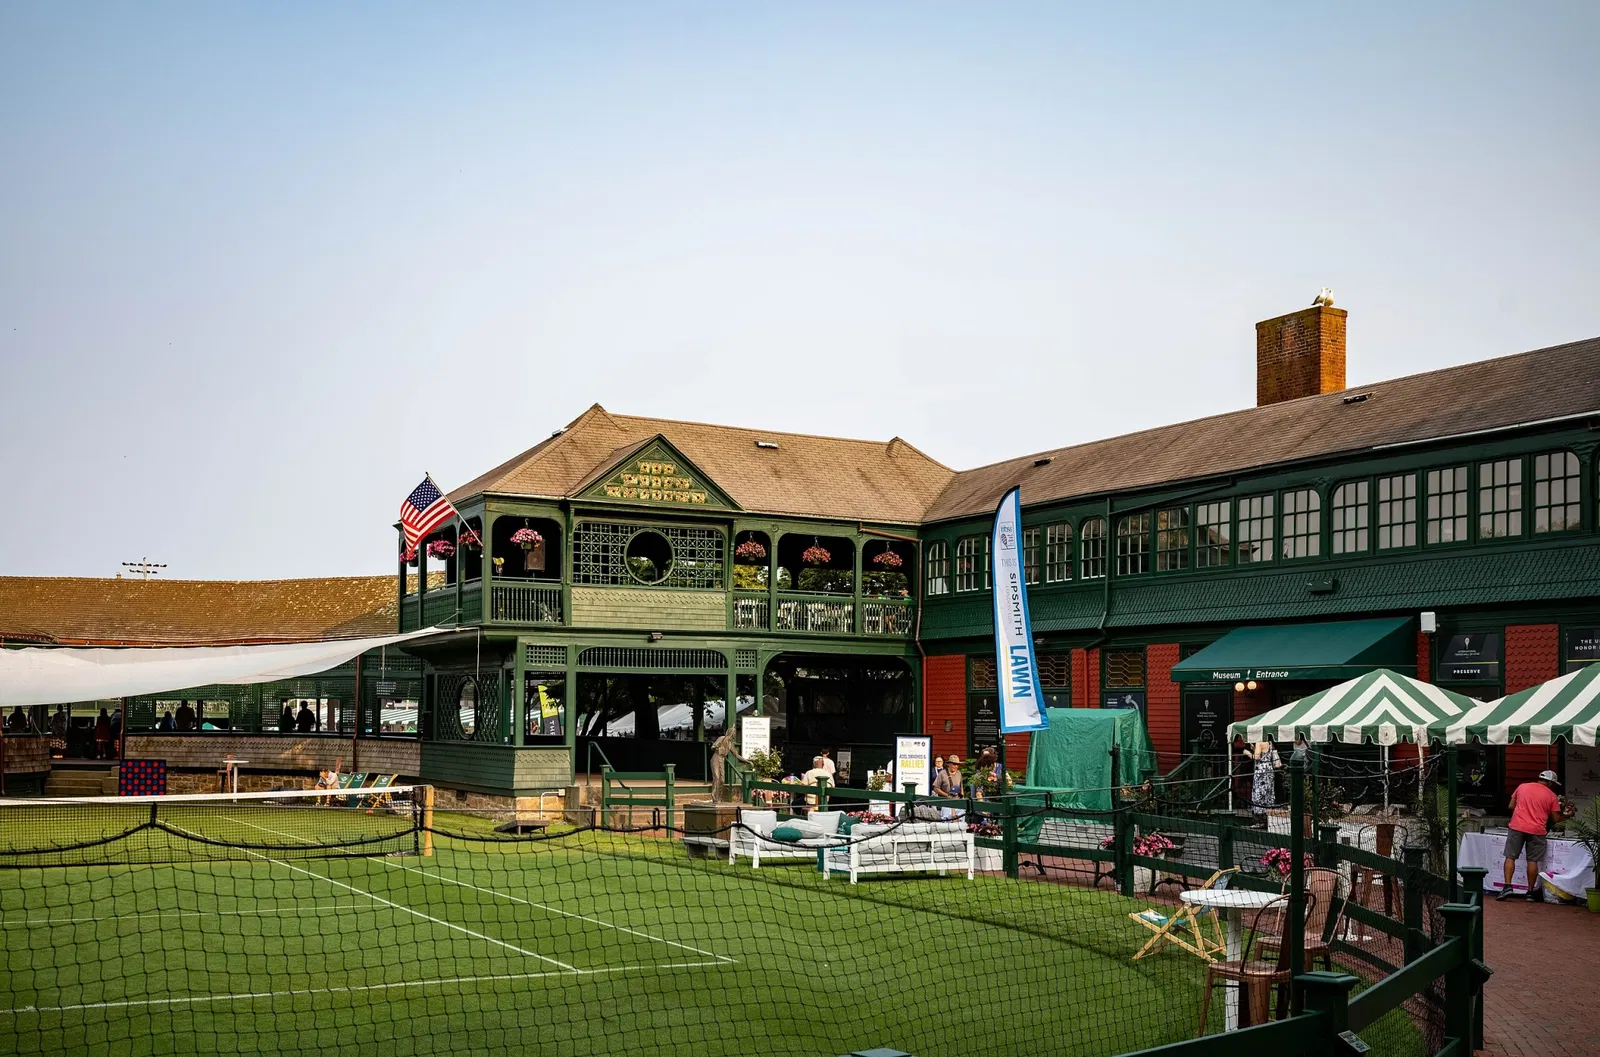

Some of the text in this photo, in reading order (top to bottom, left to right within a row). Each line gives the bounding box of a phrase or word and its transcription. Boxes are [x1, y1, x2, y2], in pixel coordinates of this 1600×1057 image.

[1009, 572, 1023, 636] SIPSMITH
[1010, 645, 1032, 698] LAWN
[1212, 670, 1289, 679] Museum Entrance
[900, 760, 925, 769] RALLIES
